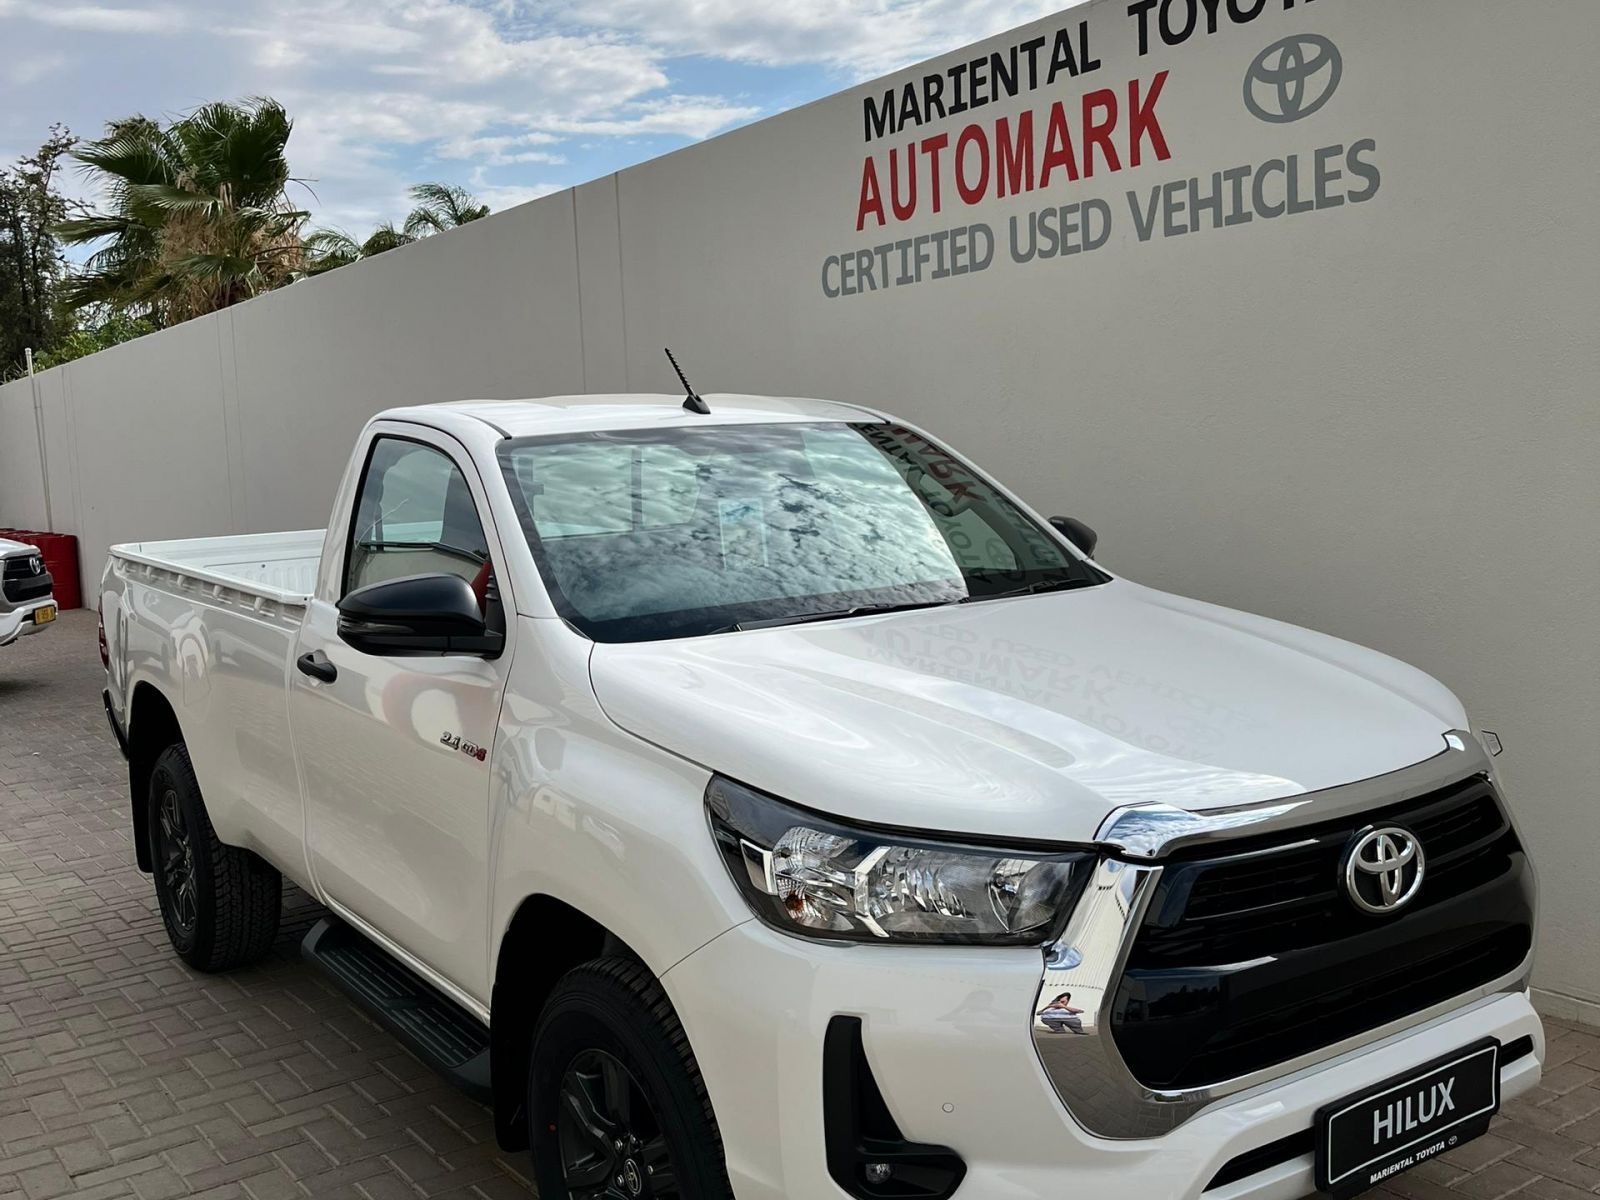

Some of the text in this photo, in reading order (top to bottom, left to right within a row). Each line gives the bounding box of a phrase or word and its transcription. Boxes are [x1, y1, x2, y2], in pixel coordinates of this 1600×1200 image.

[863, 20, 1101, 142] MARIENTAL
[856, 70, 1171, 231] AUTOMARK
[821, 138, 1381, 298] CERTIFIED USED VEHICLES
[1369, 1140, 1445, 1184] MARIENTAL TOYOTA
[1373, 1077, 1456, 1145] HILUX
